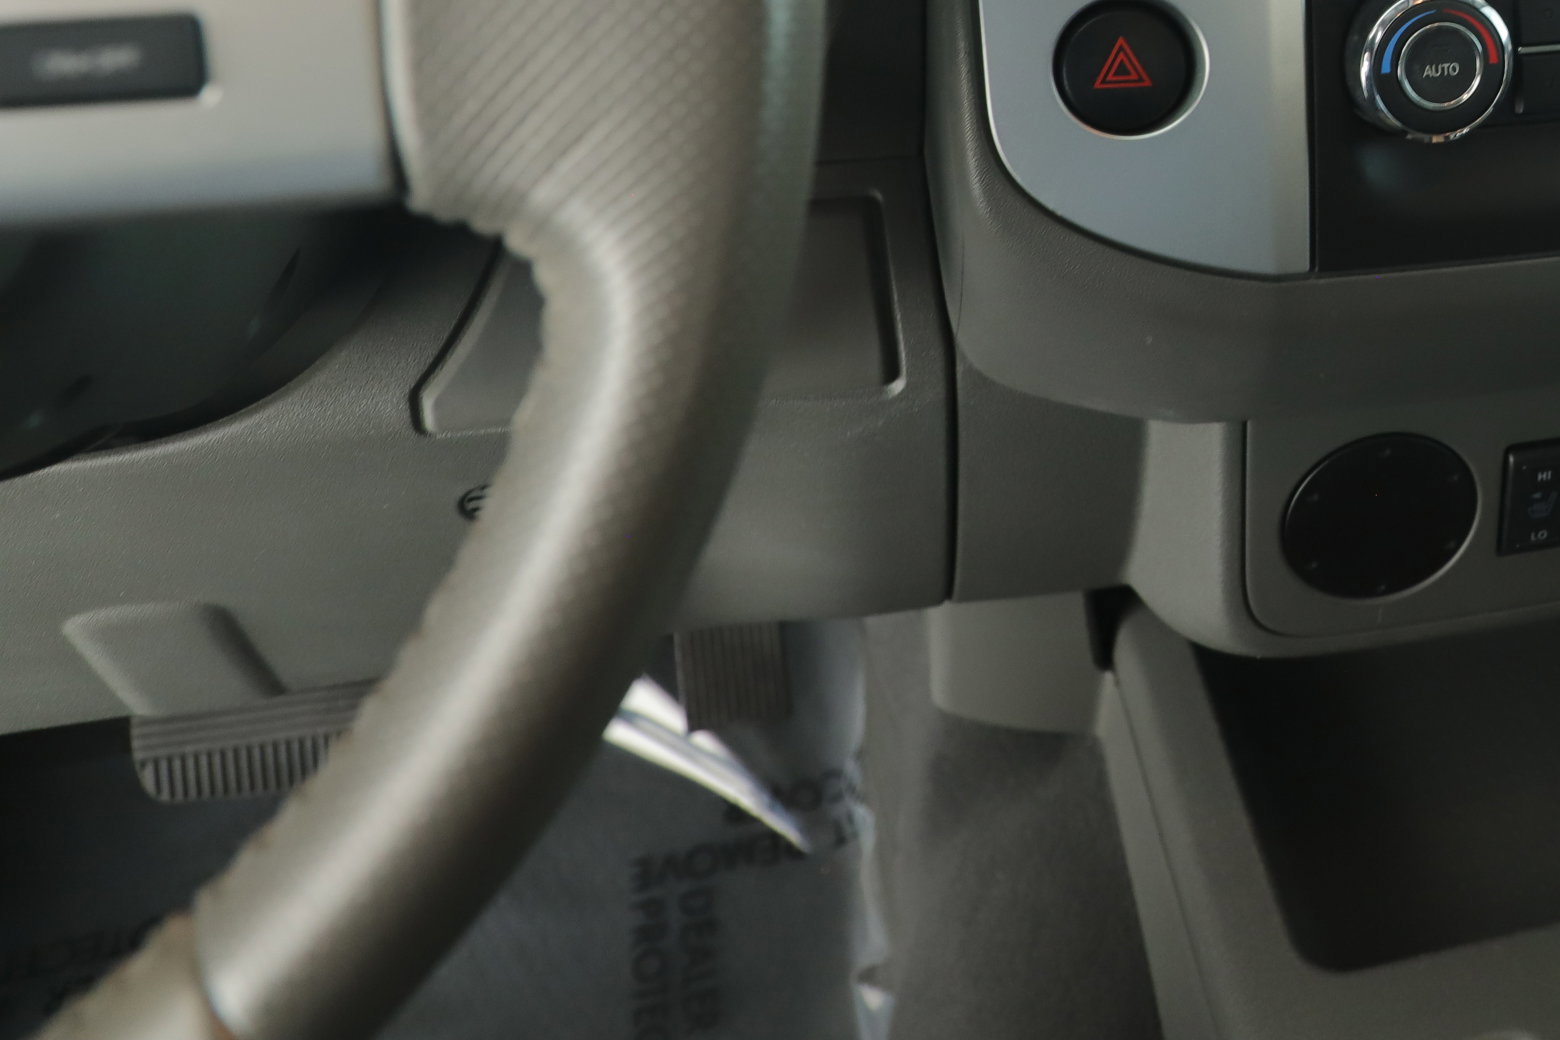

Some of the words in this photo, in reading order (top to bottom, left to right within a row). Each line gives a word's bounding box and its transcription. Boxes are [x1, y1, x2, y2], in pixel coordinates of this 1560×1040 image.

[1423, 62, 1460, 78] AUTO
[1537, 469, 1552, 482] HI
[1530, 529, 1548, 542] LO
